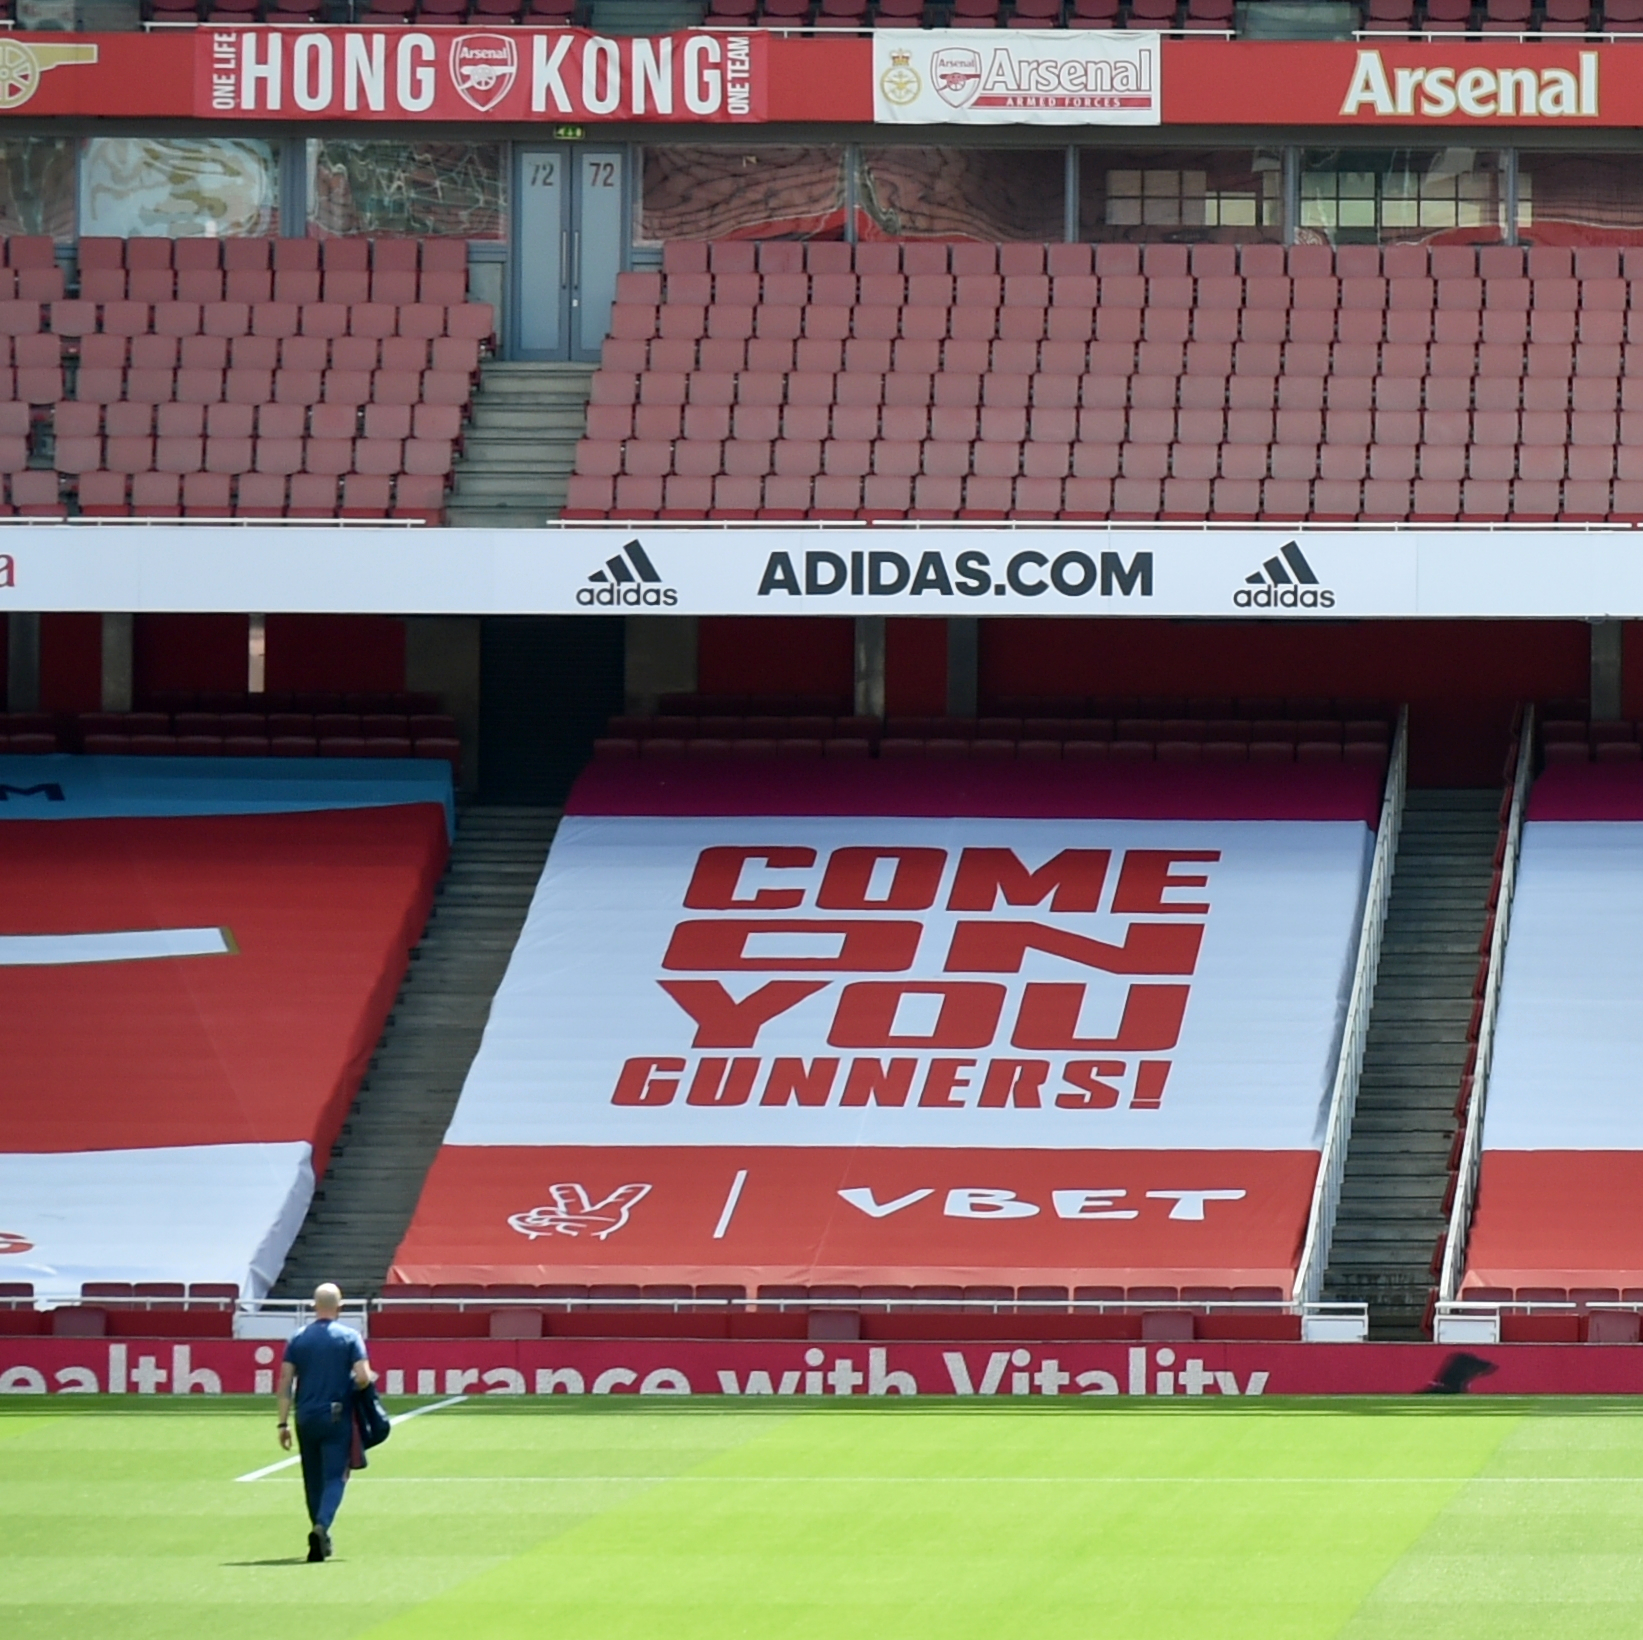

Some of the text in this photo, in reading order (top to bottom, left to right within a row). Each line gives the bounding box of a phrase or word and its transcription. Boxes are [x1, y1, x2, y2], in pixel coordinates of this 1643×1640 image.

[213, 32, 237, 109] ONE LIFE
[241, 32, 722, 115] HONG KONG
[460, 47, 509, 60] Arsenal
[727, 37, 750, 115] ONE TEAM
[982, 48, 1152, 91] Arsenal
[1006, 97, 1121, 107] ARMED FORCES
[1339, 49, 1600, 118] Arsenal
[530, 163, 555, 187] 72
[589, 163, 615, 187] 72
[576, 582, 679, 607] adidas
[758, 550, 1154, 598] ADIDAS.COM
[1233, 583, 1336, 609] adidas
[681, 846, 1221, 914] COME
[660, 919, 1205, 976] ON
[656, 979, 1190, 1052] YOU
[610, 1056, 1172, 1110] GUNNERS!
[837, 1186, 1247, 1222] VBET
[254, 1346, 692, 1395] iurance
